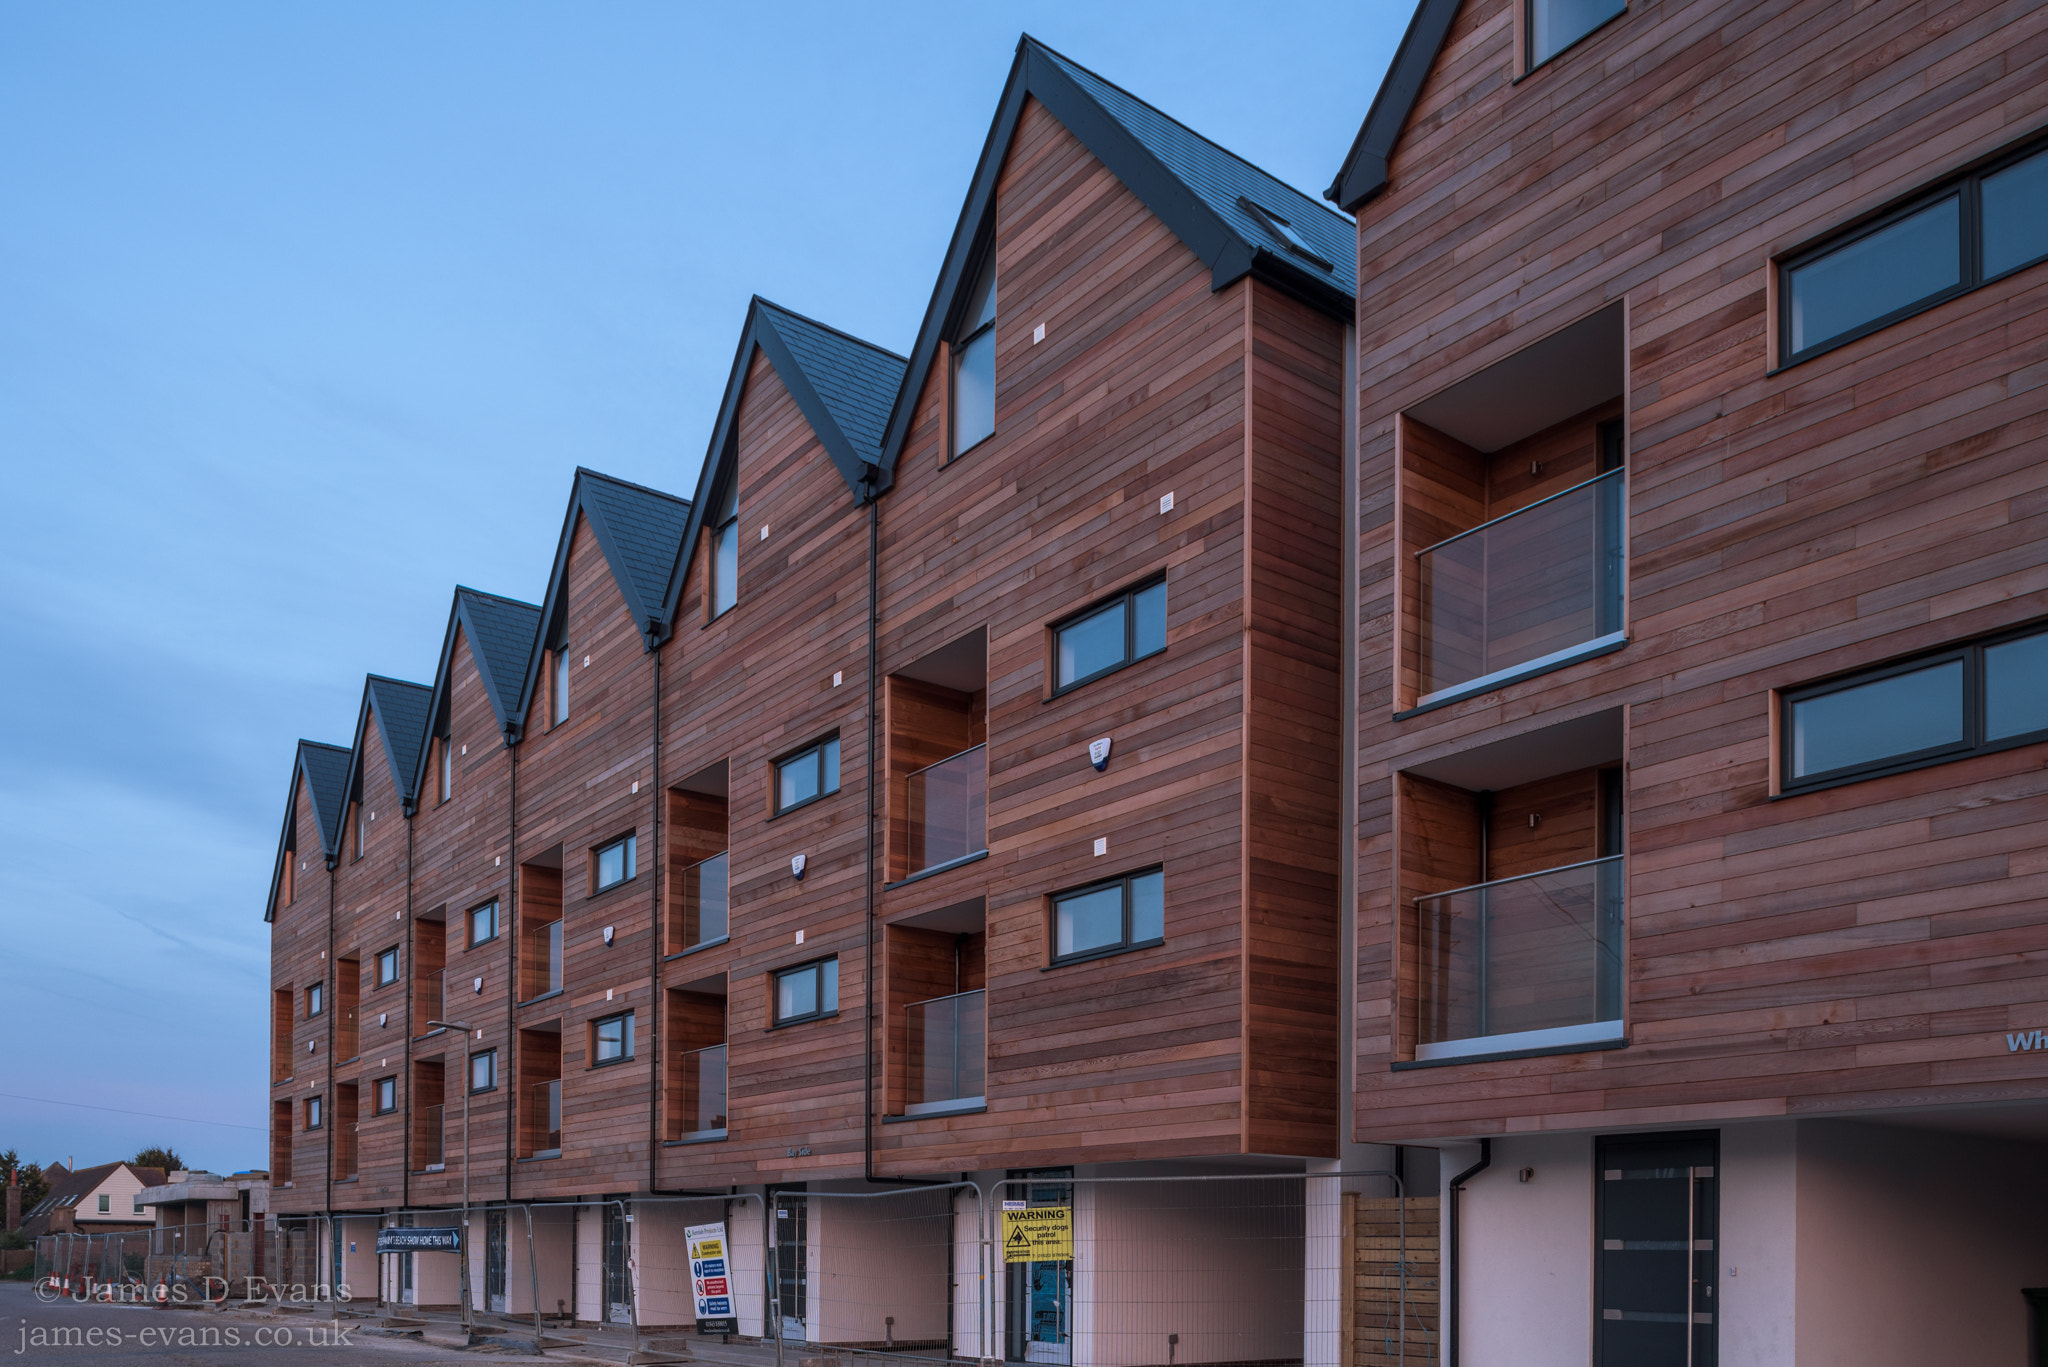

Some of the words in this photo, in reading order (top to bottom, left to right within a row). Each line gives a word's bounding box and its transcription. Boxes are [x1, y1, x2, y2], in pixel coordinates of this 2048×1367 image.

[787, 1148, 798, 1159] Bay
[799, 1147, 811, 1156] Side
[1007, 1210, 1065, 1221] WARNING
[406, 1236, 419, 1246] SHOW
[419, 1236, 433, 1245] HOME
[433, 1236, 442, 1245] THIS
[442, 1236, 452, 1245] WAY
